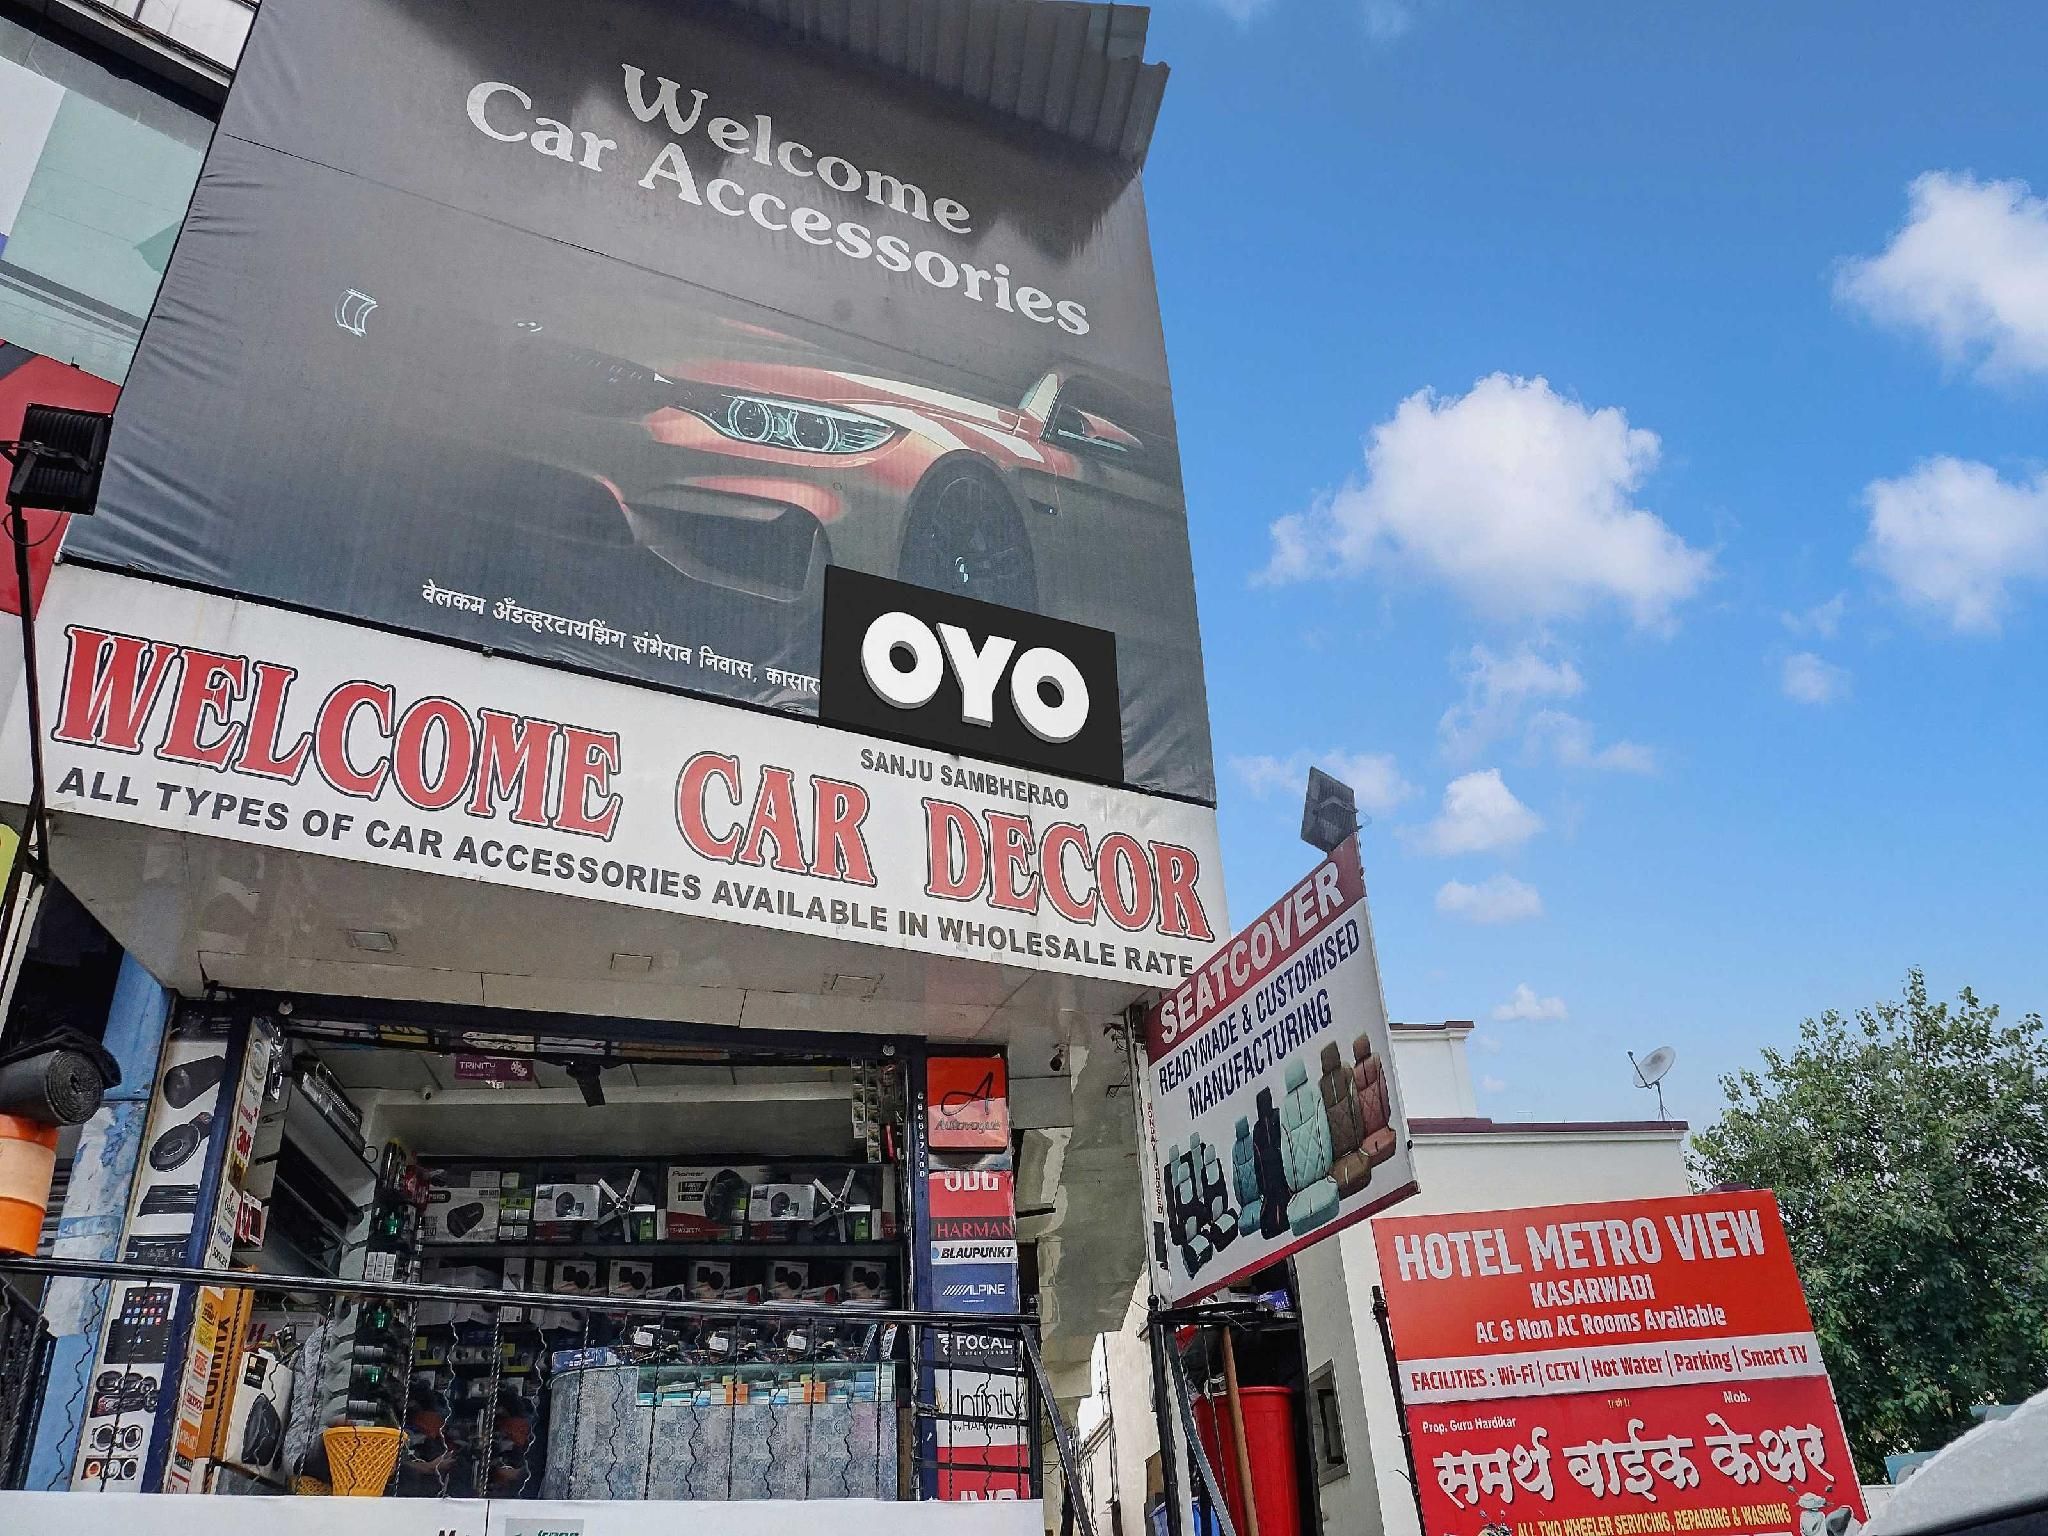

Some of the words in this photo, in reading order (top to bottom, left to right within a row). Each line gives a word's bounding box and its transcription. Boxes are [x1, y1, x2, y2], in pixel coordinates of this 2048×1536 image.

[622, 63, 972, 234] Welcome
[466, 81, 617, 171] Car
[639, 142, 1090, 335] Accessories
[422, 579, 485, 615] वेलकम
[633, 631, 692, 665] संभेराव
[766, 666, 820, 694] कासार
[861, 611, 1090, 744] OYO
[51, 624, 622, 843] WELCOME
[675, 750, 877, 887] CAR
[922, 797, 1215, 943] DECOR
[861, 748, 934, 783] SANJU
[940, 764, 1069, 809] SAMBHERAO
[56, 766, 139, 806] ALL
[156, 782, 289, 831] TYPES
[301, 808, 353, 840] OF
[366, 819, 443, 859] CAR
[453, 835, 701, 902] ACCESSORIES
[711, 880, 888, 932] AVAILABLE
[898, 910, 929, 939] IN
[936, 916, 1117, 968] WHOLESALE
[1124, 946, 1194, 978] RATE
[1160, 861, 1344, 1044] SEATCOVER
[1158, 1012, 1239, 1096] READYMADE
[1241, 1004, 1253, 1034] &
[1255, 918, 1360, 1024] CUSTOMISED
[1188, 988, 1332, 1120] MANUFACTURING
[936, 1222, 1013, 1239] HARMAN
[941, 1247, 1014, 1259] BLAUPUNKT
[1394, 1228, 1522, 1282] HOTEL
[1525, 1216, 1663, 1272] METRO
[1665, 1209, 1766, 1260] VIEW
[943, 1284, 1005, 1295] ALPINE
[1530, 1273, 1655, 1308] KASARWADI
[956, 1335, 1013, 1350] FOCAL
[1476, 1321, 1498, 1343] AC
[1500, 1319, 1514, 1342] &
[1517, 1318, 1553, 1341] Non
[1556, 1315, 1580, 1337] AC
[1582, 1312, 1641, 1335] Rooms
[1644, 1302, 1728, 1331] Available
[1411, 1368, 1487, 1391] FACILITIES
[1497, 1364, 1535, 1387] Wi-Fi
[1545, 1361, 1581, 1382] CCTV
[1591, 1357, 1618, 1378] Hot
[1620, 1351, 1663, 1376] Water
[1673, 1350, 1734, 1373] Parking
[1741, 1346, 1788, 1368] Smart
[1788, 1345, 1809, 1364] TV
[1723, 1391, 1751, 1404] Mob.
[956, 1384, 1018, 1417] Infinity
[1422, 1421, 1447, 1435] Prop.
[1450, 1419, 1473, 1432] Guru
[1475, 1416, 1517, 1430] Hardikar
[1433, 1426, 1556, 1509] समर्थ
[1562, 1413, 1699, 1502] बाईक
[1704, 1412, 1835, 1487] केअर
[1517, 1522, 1535, 1536] ALL
[1538, 1519, 1561, 1536] TWO
[1563, 1516, 1613, 1536] WHEELER
[1675, 1507, 1731, 1531] REPAIRING
[1732, 1505, 1740, 1527] &
[1741, 1503, 1792, 1526] WASHING
